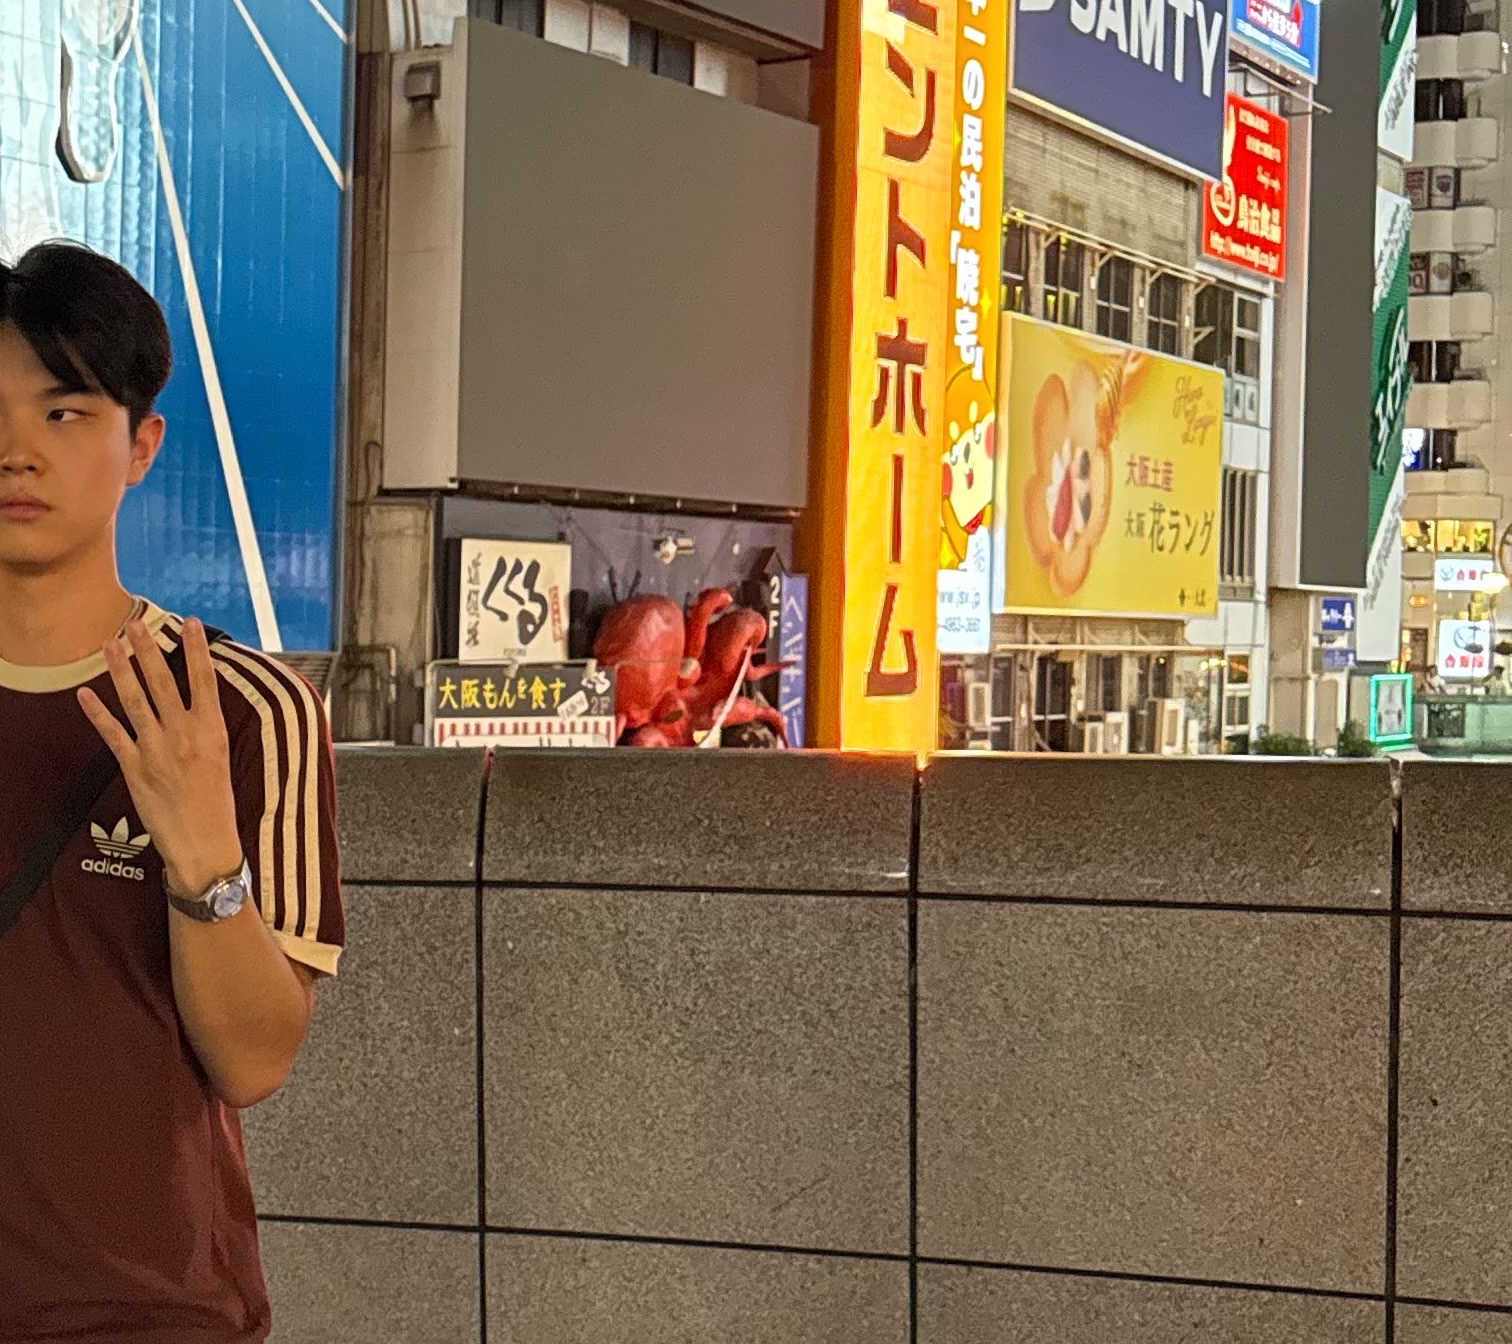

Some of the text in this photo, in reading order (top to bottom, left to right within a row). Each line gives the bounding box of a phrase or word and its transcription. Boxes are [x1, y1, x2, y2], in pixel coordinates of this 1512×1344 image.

[438, 675, 567, 710] 大阪もんを食す
[80, 858, 145, 881] adidas
